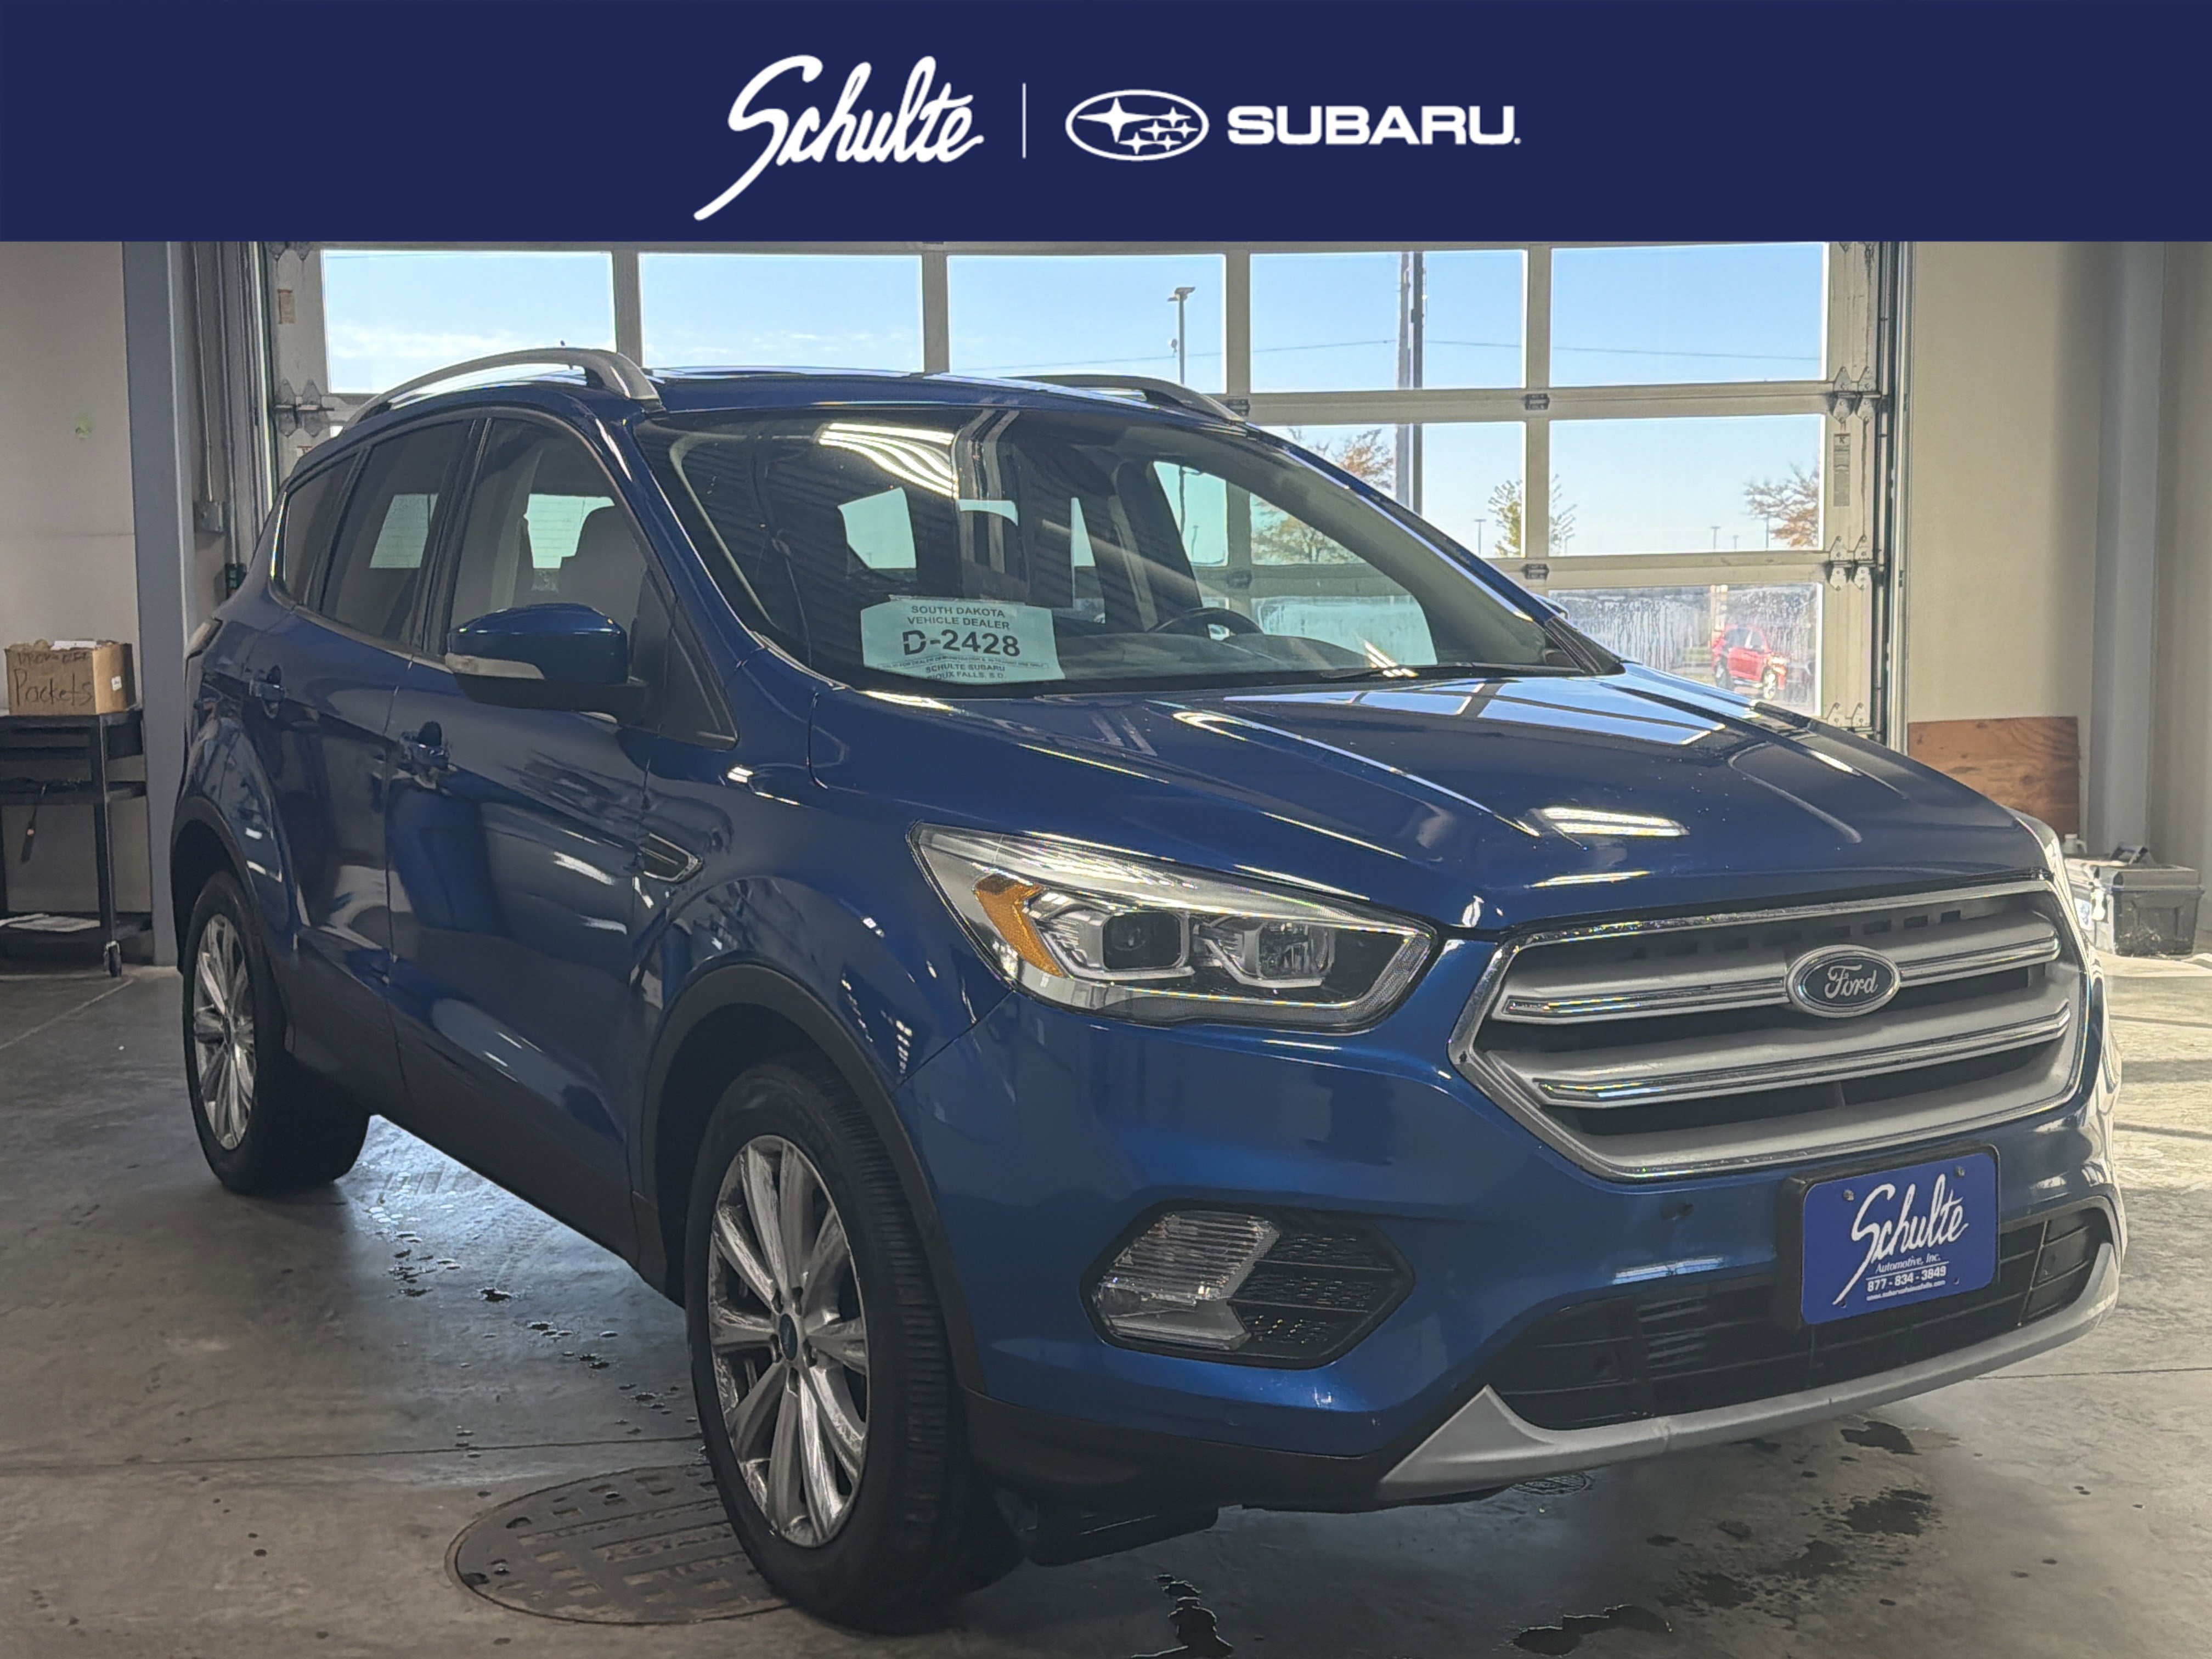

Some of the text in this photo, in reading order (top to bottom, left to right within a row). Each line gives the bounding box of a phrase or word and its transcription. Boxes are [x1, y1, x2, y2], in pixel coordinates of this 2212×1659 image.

[911, 605, 1005, 618] SOUTH DAKOTA
[907, 616, 1011, 630] VEHICLE DEALER
[902, 629, 1021, 657] D-2428
[926, 663, 1005, 674] SCHULTE SUBARU
[14, 668, 93, 707] Packets
[1824, 964, 1878, 999] Ford
[1832, 1173, 1969, 1306] Schulte
[1926, 1252, 1941, 1263] Inc.
